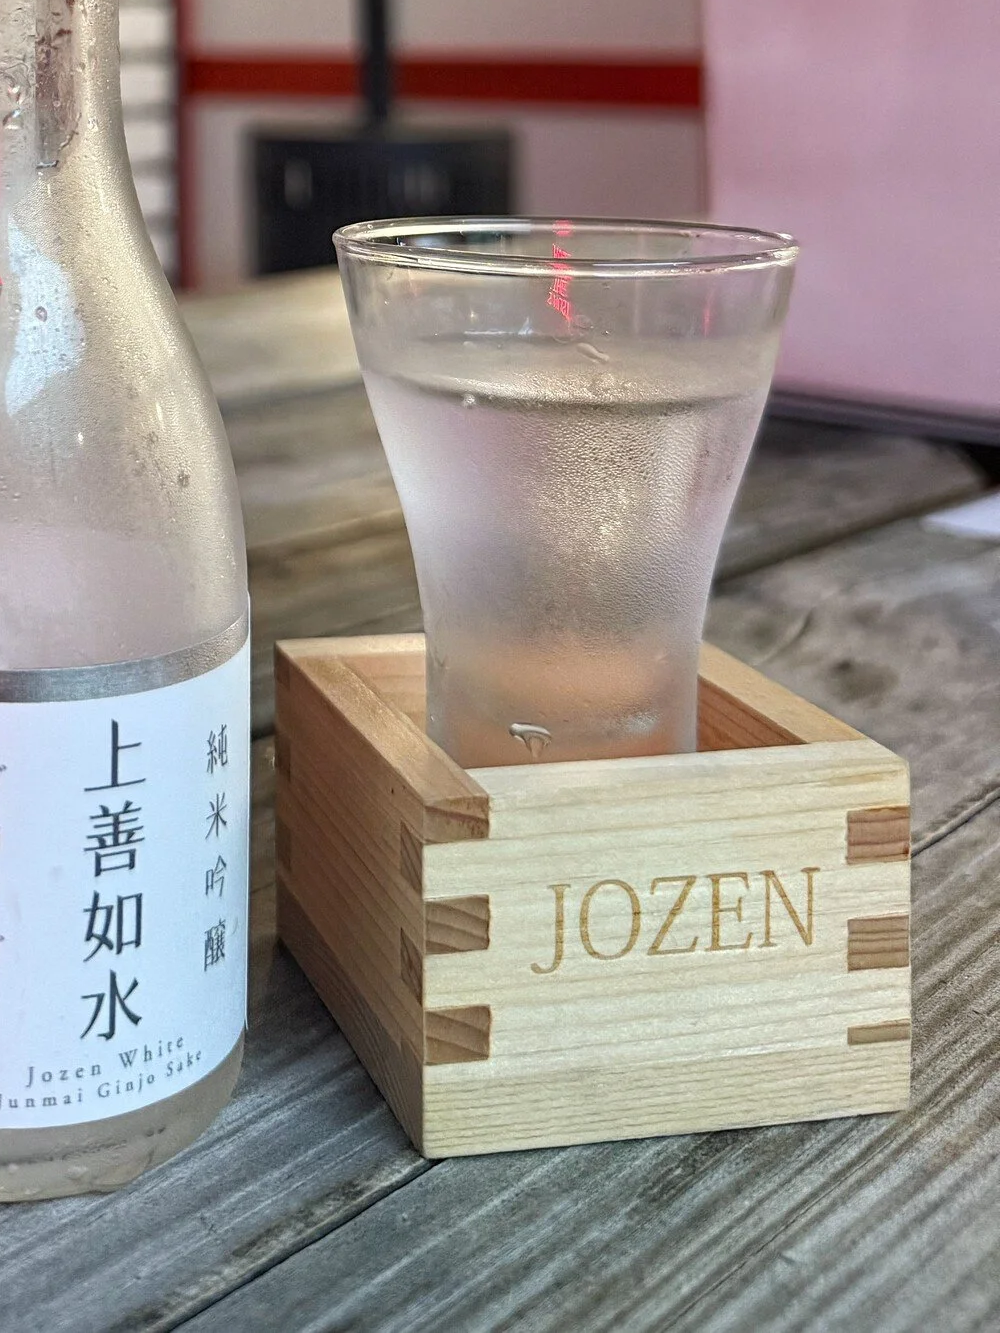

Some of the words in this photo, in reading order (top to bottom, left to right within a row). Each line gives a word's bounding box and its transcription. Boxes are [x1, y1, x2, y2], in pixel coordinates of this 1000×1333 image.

[80, 718, 147, 1041] 上善如水
[203, 723, 229, 973] 純米吟醸
[530, 866, 822, 975] JOZEN
[26, 1064, 102, 1088] Jozen
[118, 1036, 184, 1069] White
[97, 1073, 155, 1099] Ginjo
[166, 1050, 202, 1078] Sake
